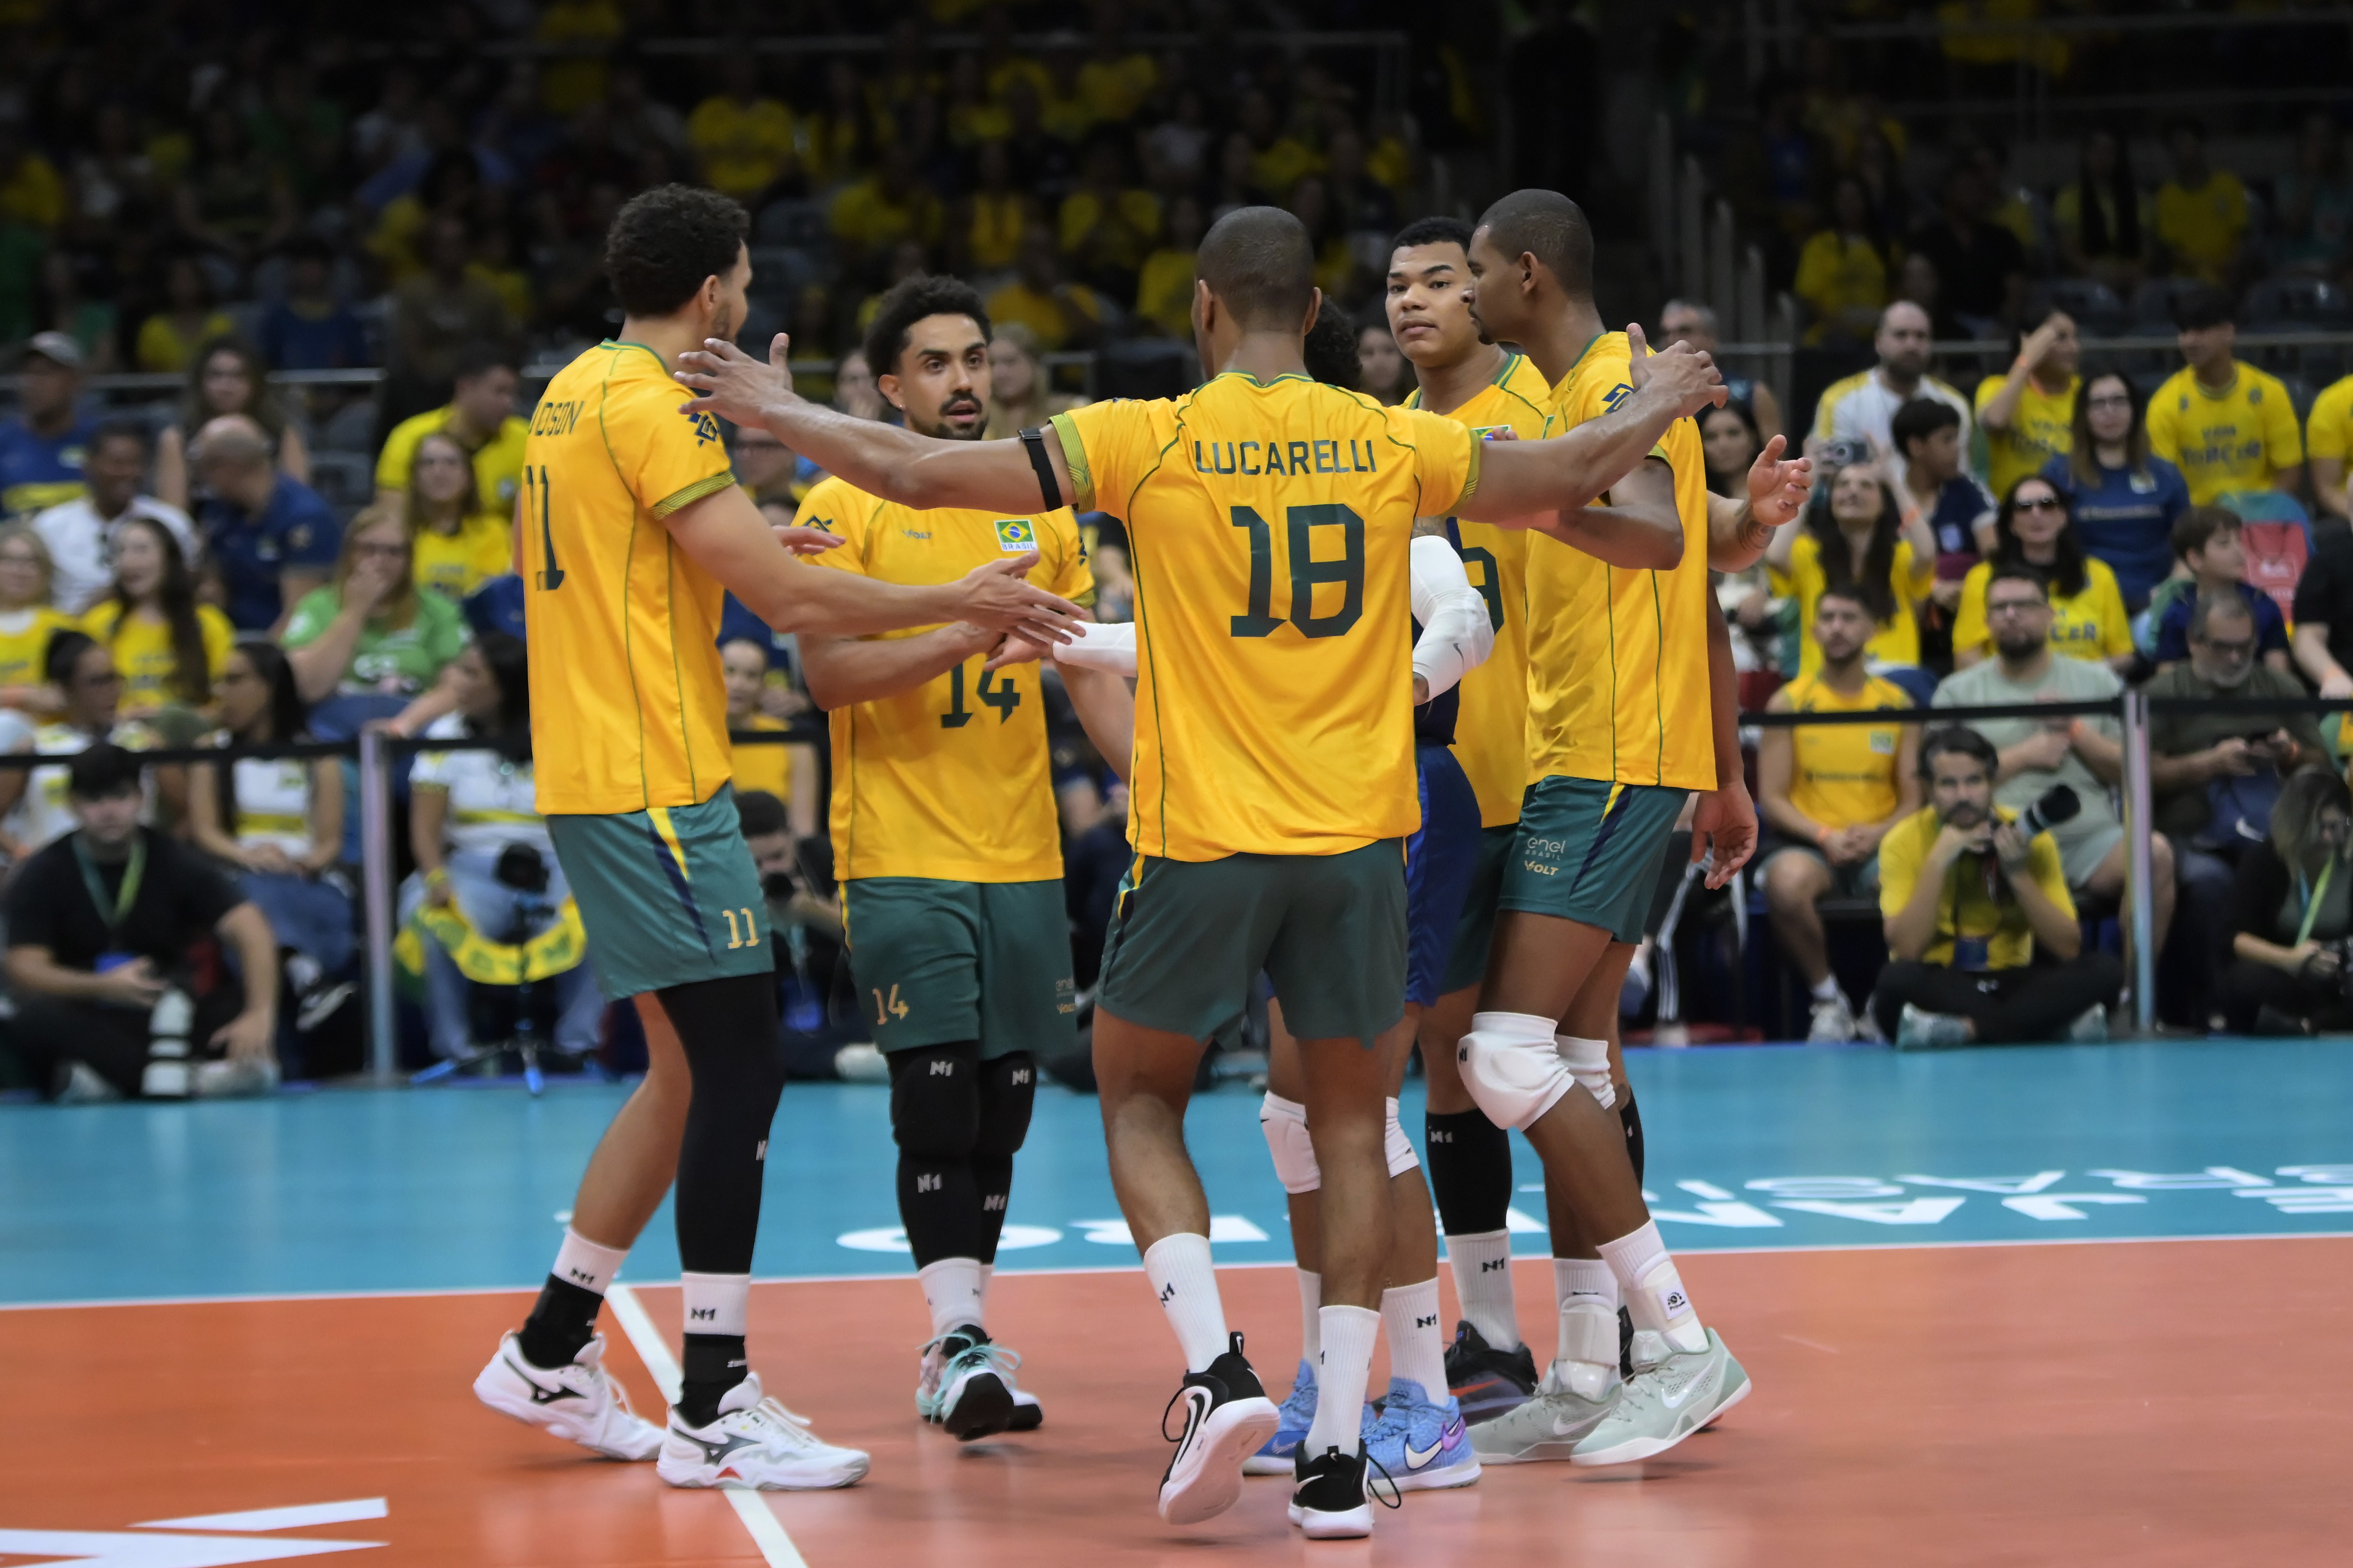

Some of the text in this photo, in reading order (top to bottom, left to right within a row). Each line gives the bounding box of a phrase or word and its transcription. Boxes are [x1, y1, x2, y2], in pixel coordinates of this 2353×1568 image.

[1195, 439, 1377, 476] LUCARELLI
[1002, 542, 1036, 550] BRASIL
[1230, 503, 1365, 639] 18
[940, 660, 1020, 729] 14
[1528, 837, 1566, 854] enel
[1524, 860, 1558, 876] VOLT
[722, 908, 759, 949] 11
[872, 984, 909, 1025] 14
